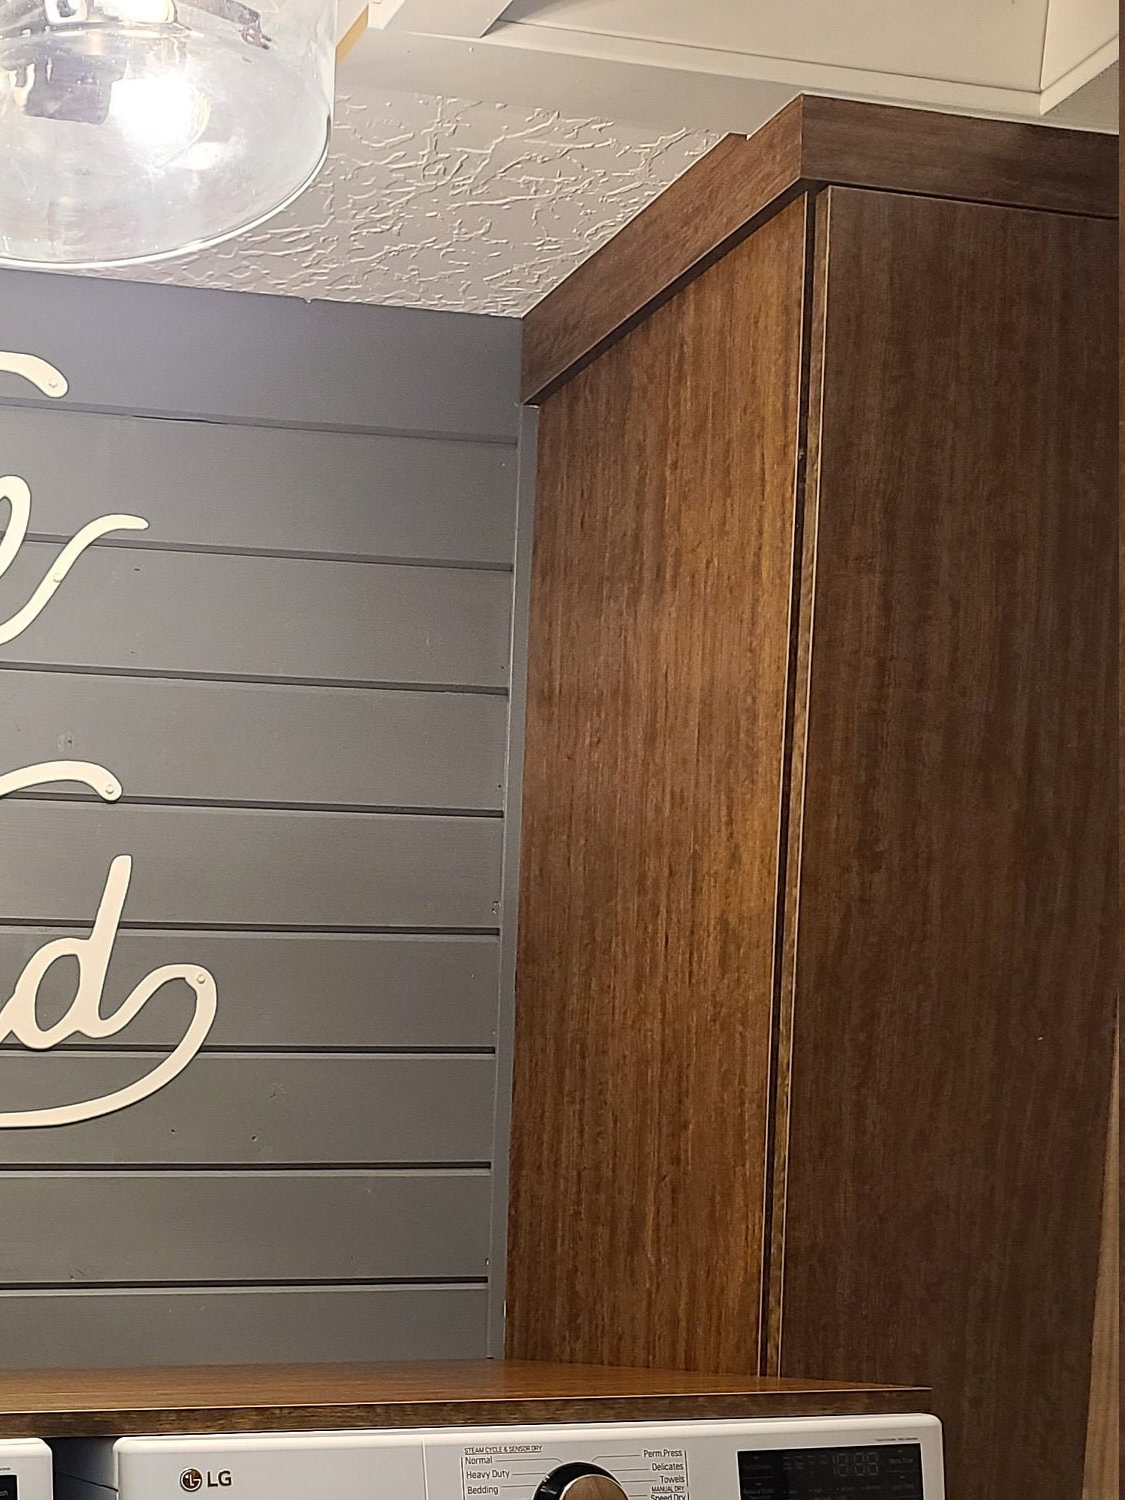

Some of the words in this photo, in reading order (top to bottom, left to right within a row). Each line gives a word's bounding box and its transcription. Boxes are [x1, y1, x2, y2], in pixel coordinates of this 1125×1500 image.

[465, 1456, 493, 1465] Normal
[651, 1462, 684, 1472] Delicates
[207, 1470, 232, 1488] LG
[466, 1470, 491, 1480] Heavy
[491, 1469, 510, 1479] Duty
[659, 1475, 685, 1484] Towels
[467, 1485, 499, 1496] Bedding
